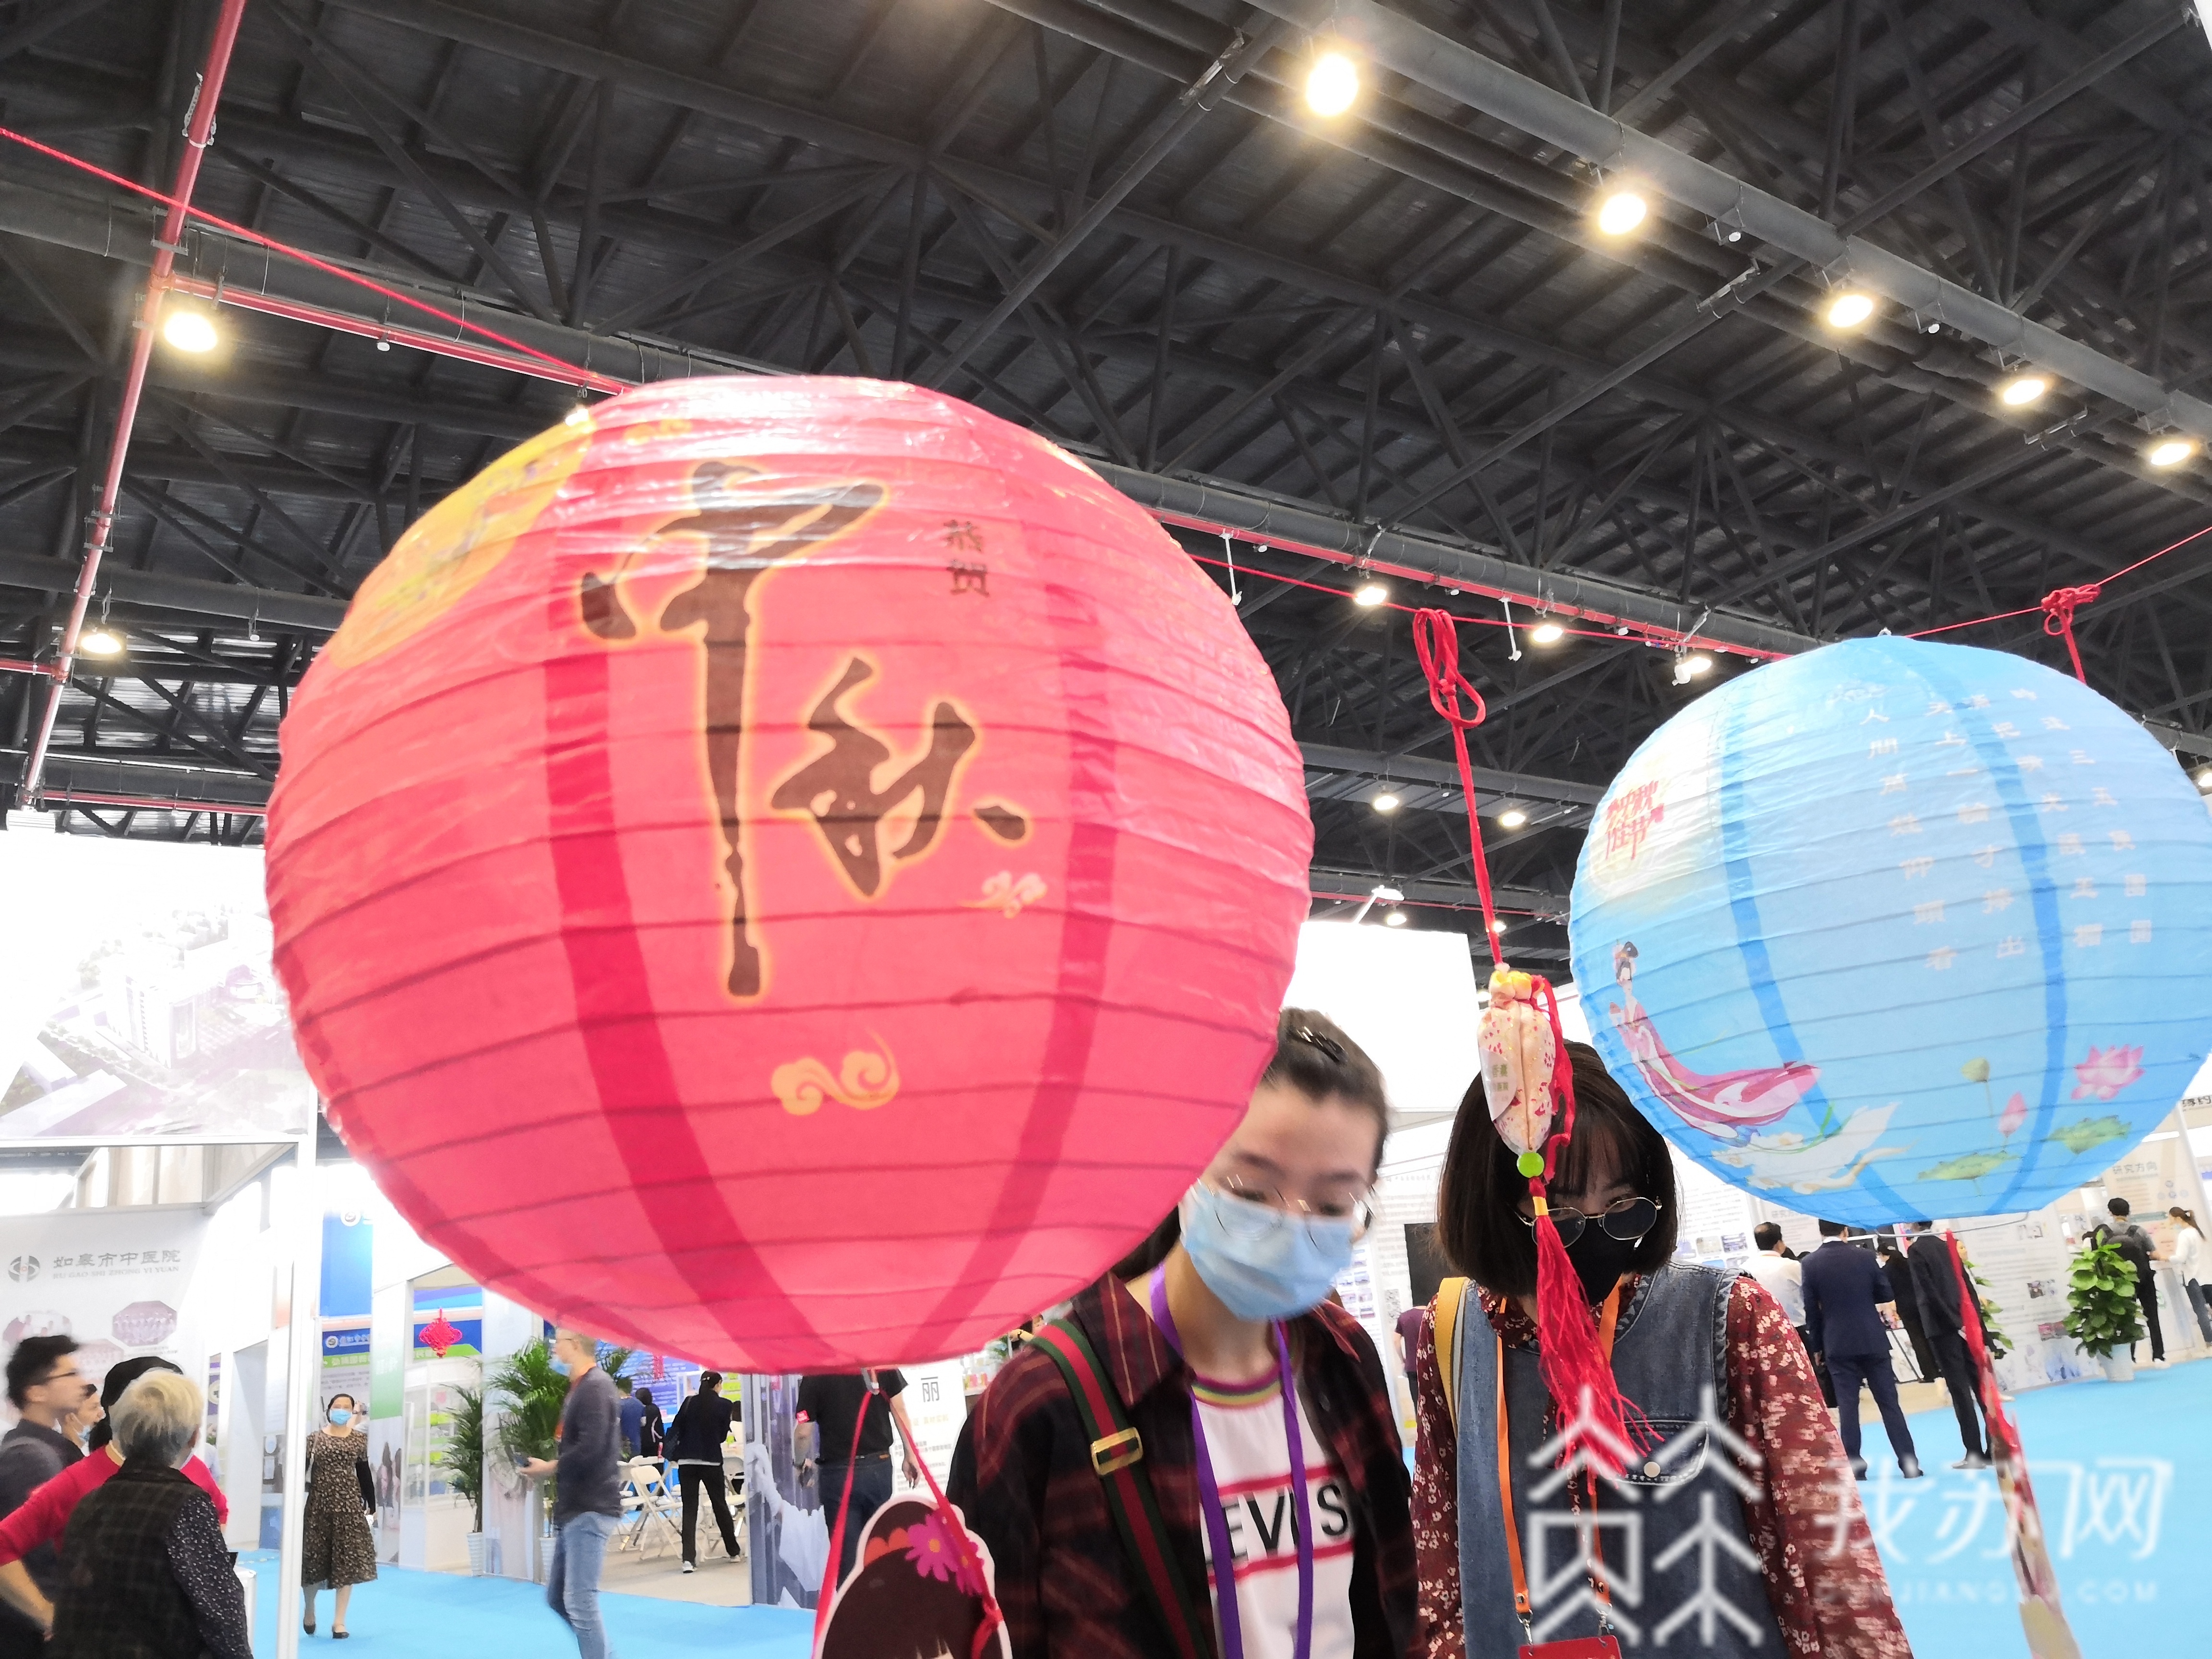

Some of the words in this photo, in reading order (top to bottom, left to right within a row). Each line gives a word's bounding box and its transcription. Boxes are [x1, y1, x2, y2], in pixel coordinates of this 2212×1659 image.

[53, 1250, 181, 1269] 如皋市中医院
[920, 1376, 940, 1403] 丽
